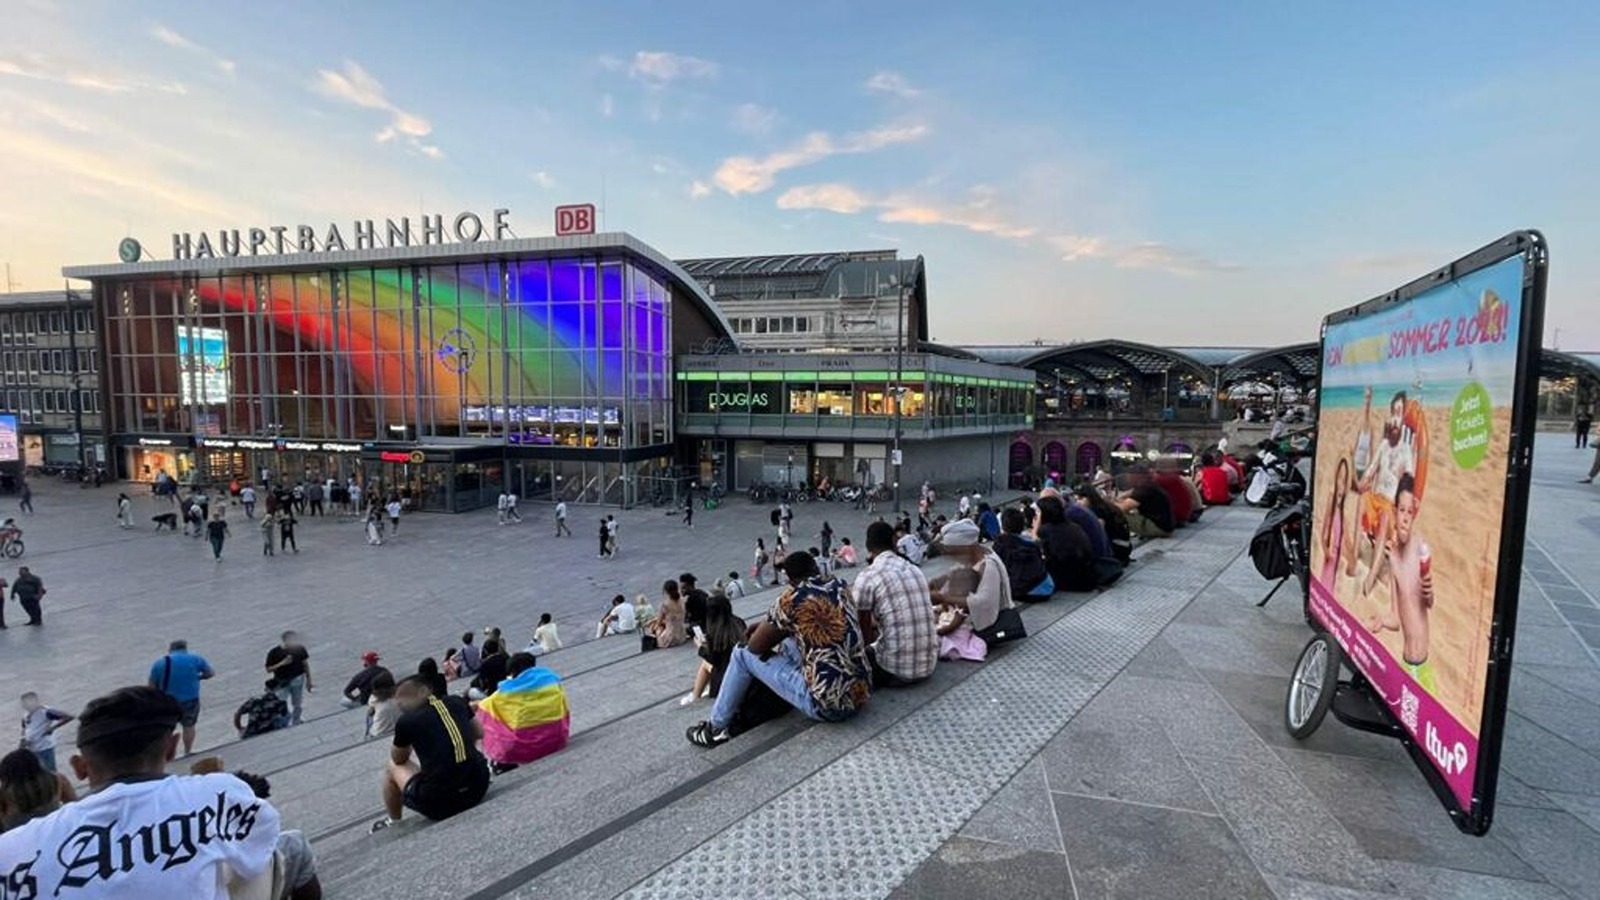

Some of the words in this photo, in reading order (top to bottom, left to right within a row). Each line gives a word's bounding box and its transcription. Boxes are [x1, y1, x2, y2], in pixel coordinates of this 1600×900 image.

[172, 209, 512, 260] HAUPTBAHNHOF
[560, 209, 589, 231] DB
[1388, 318, 1451, 359] SOMMER
[53, 792, 261, 896] Angeles
